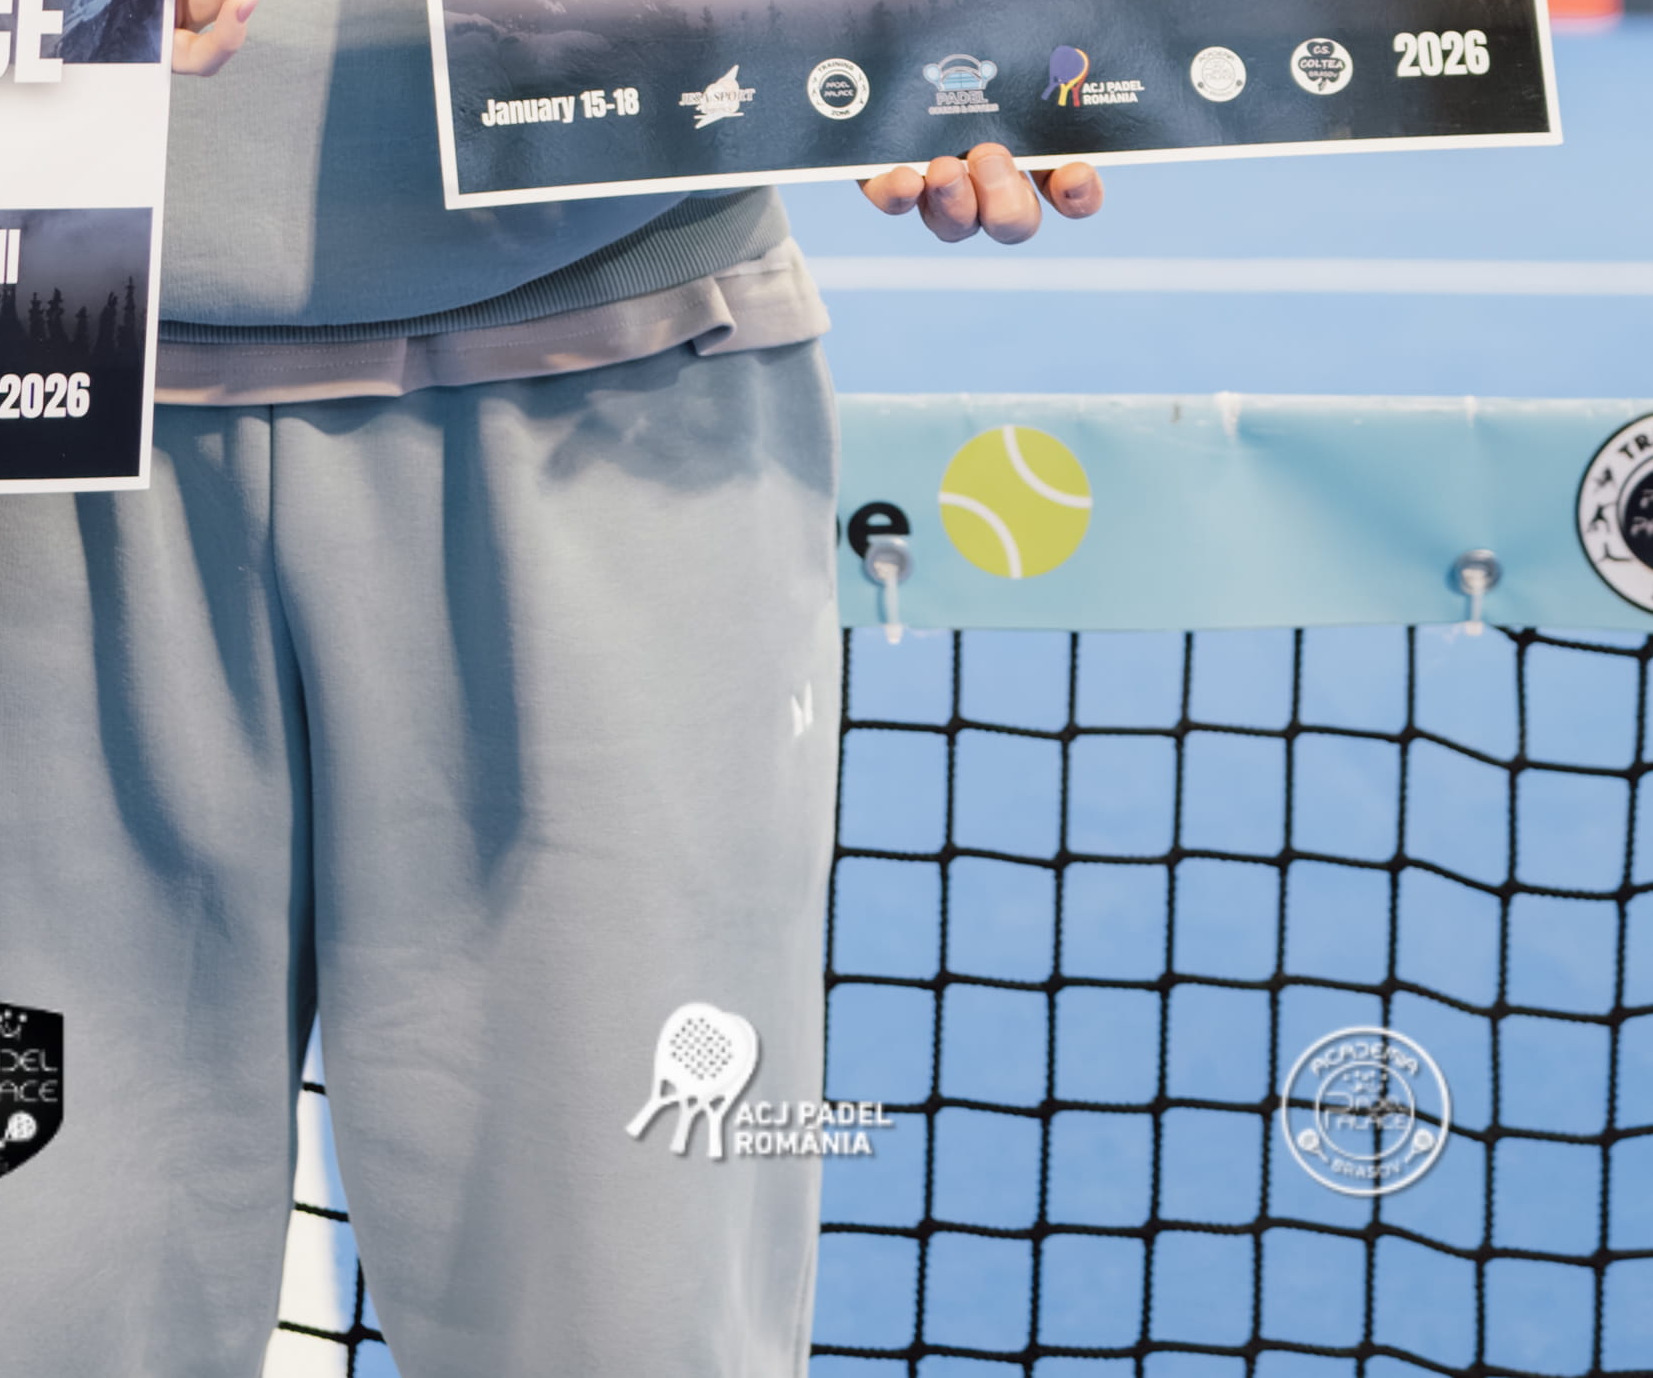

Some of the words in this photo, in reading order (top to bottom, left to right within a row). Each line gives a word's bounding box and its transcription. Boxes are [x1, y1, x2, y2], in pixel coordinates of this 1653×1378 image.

[1393, 29, 1490, 78] 2026
[1300, 58, 1344, 70] COLTEA
[1082, 82, 1105, 94] ACJ
[1106, 80, 1145, 92] PADEL
[936, 90, 989, 106] PADEL
[480, 92, 575, 129] January
[579, 87, 641, 120] 15-18
